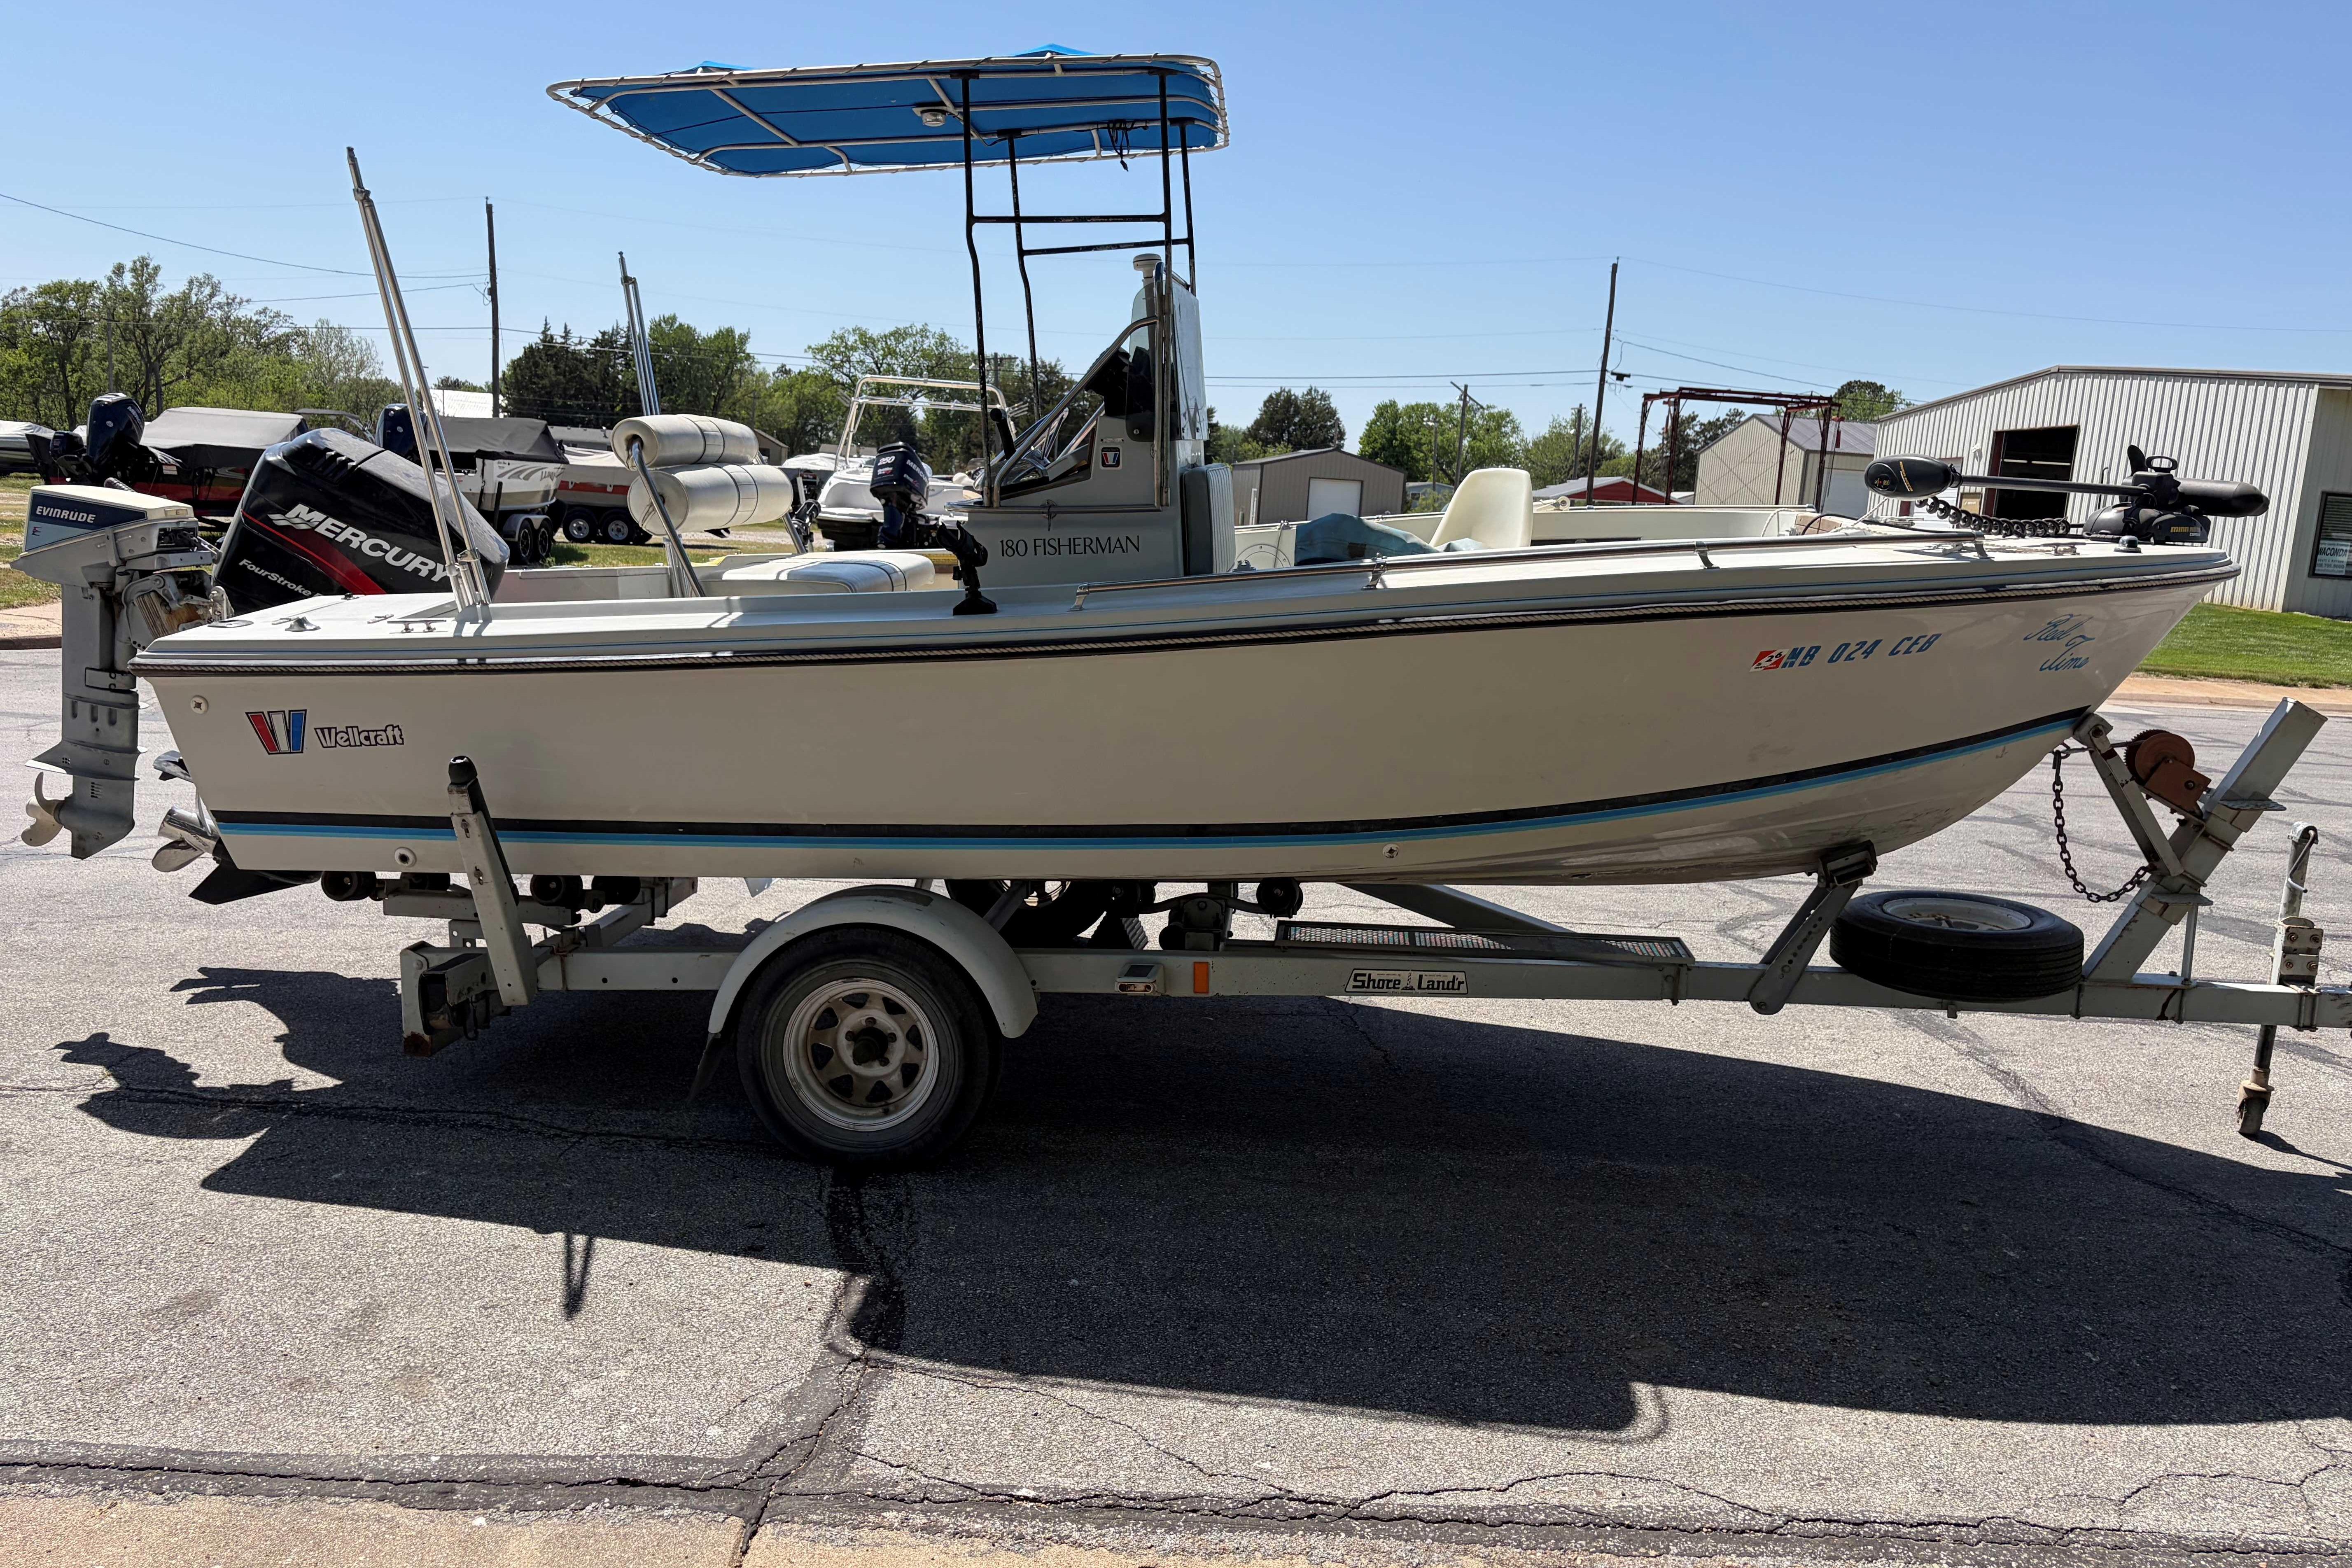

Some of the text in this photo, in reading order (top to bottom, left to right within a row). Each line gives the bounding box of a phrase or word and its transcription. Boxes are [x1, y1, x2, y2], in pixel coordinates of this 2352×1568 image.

[877, 456, 896, 466] 250
[36, 506, 96, 523] EVINRUDE
[284, 503, 449, 582] MERCURY
[999, 535, 1140, 557] 180 FISHERMAN
[238, 558, 312, 596] FourStroke
[1765, 651, 1783, 663] 26
[1827, 639, 1883, 663] 024
[1888, 633, 1942, 656] CEB
[314, 724, 404, 748] Wellcraft
[1352, 973, 1465, 991] Shore Land'r
